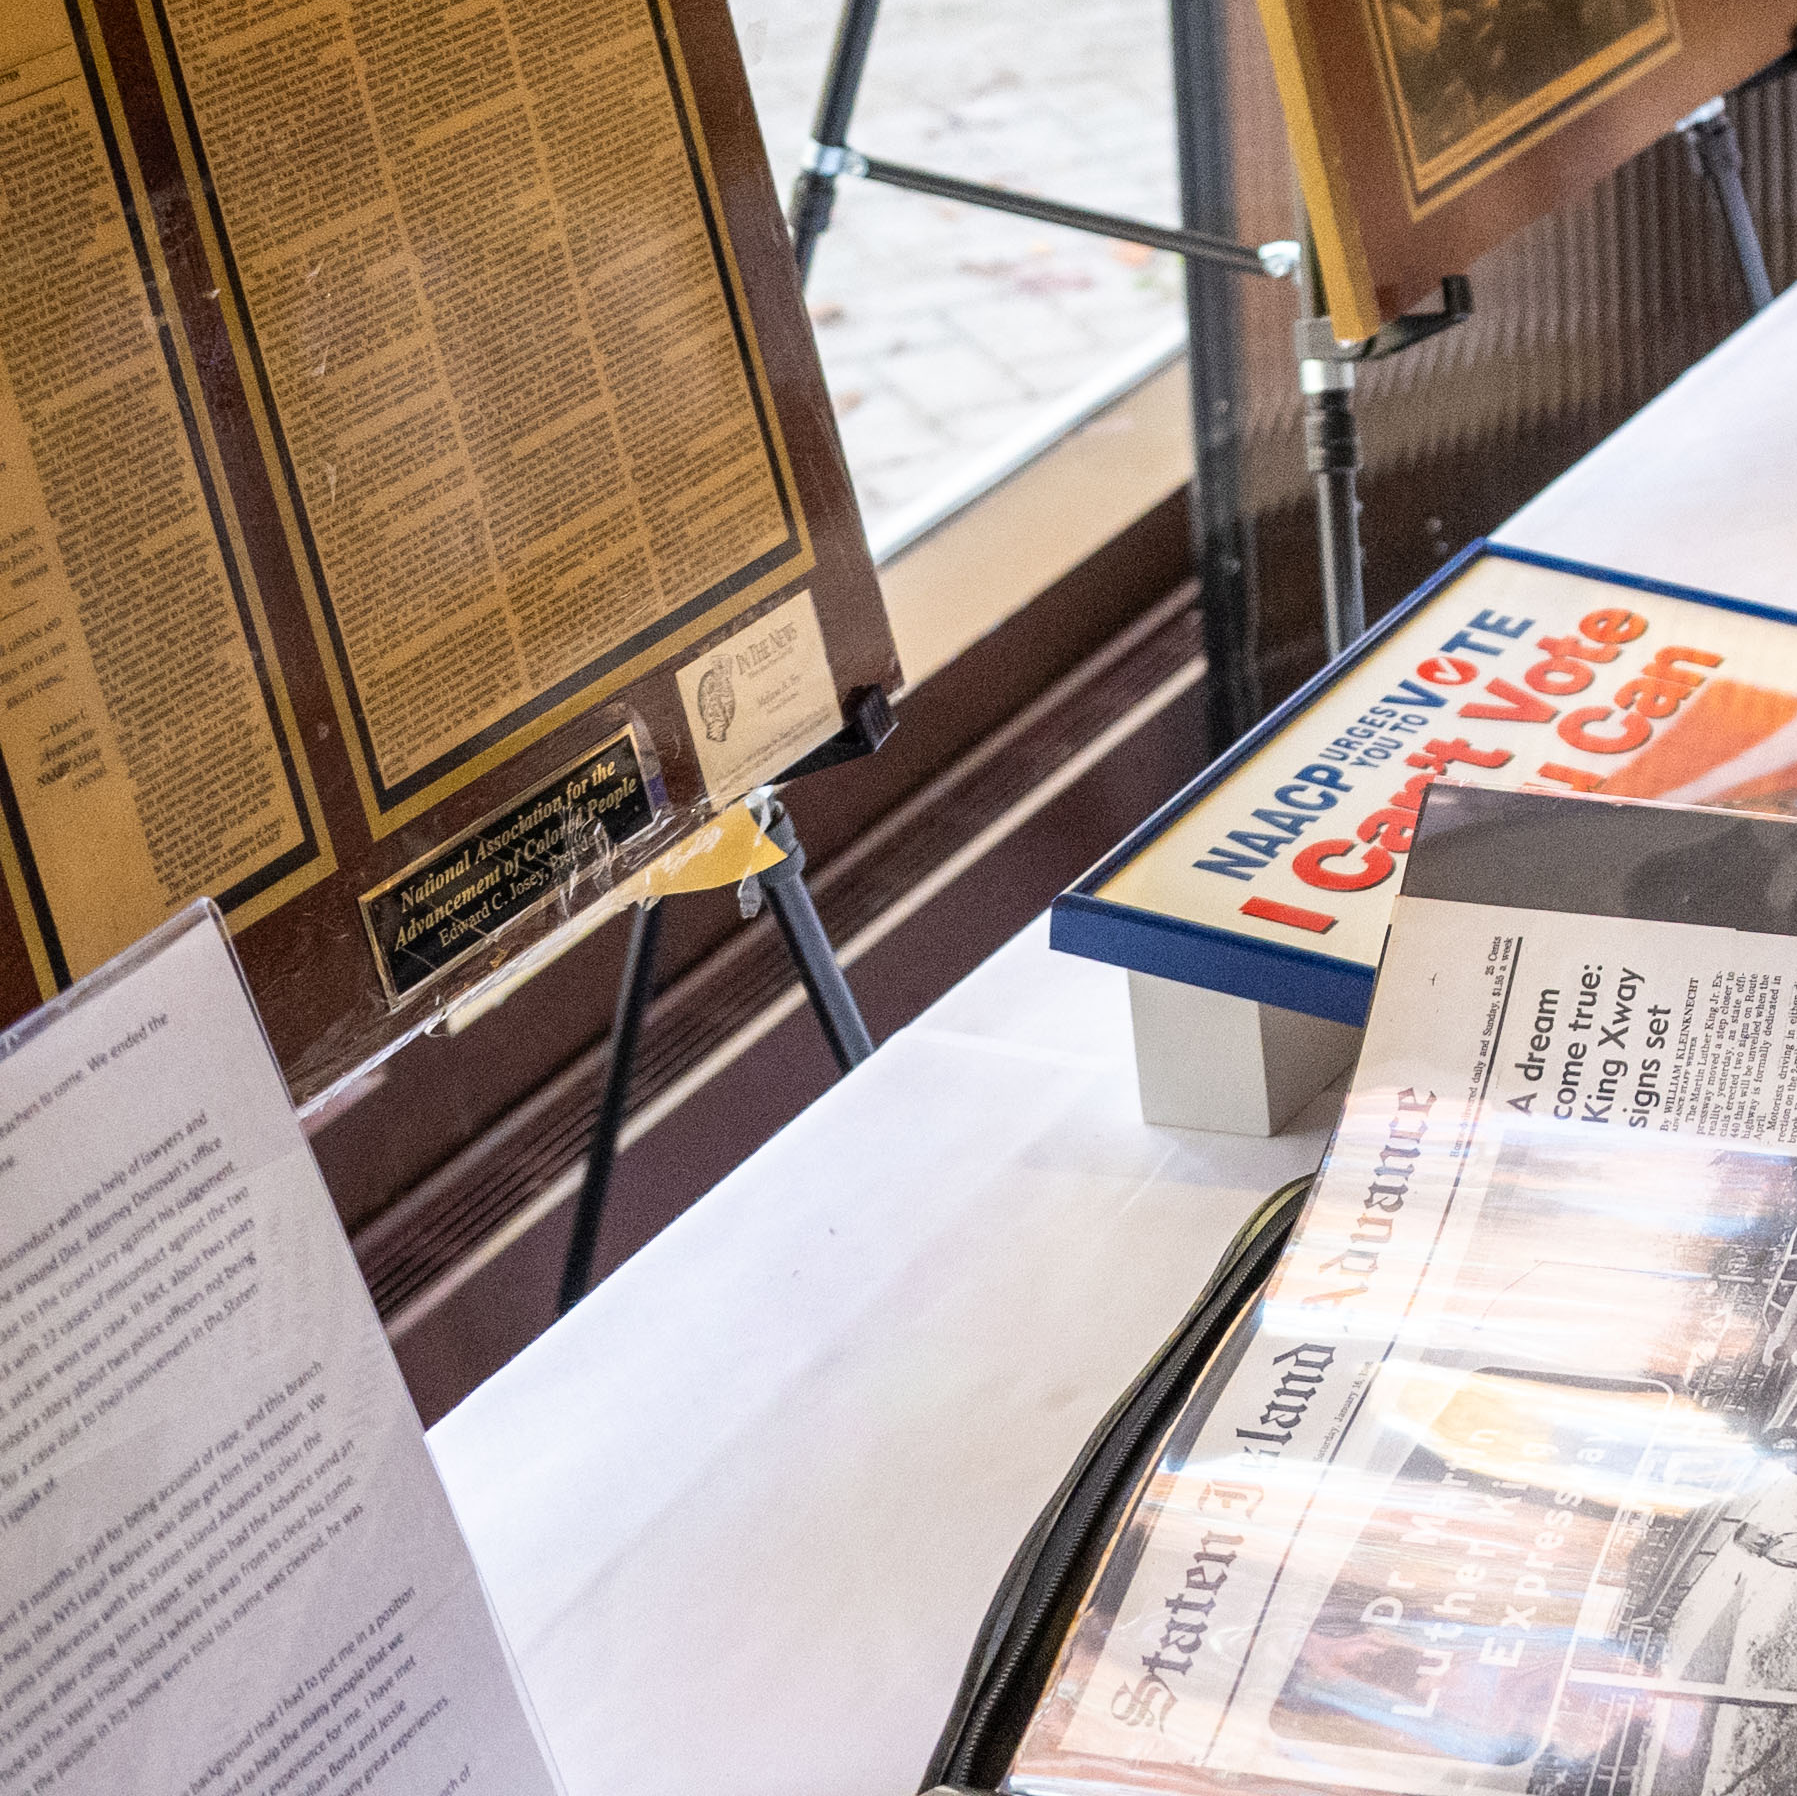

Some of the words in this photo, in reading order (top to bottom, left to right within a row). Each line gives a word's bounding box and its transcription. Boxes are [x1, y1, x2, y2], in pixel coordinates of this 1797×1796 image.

[1382, 611, 1530, 707] VOTE
[1558, 647, 1721, 754] Can
[1320, 707, 1396, 760] URGES
[1350, 736, 1402, 767] YOU
[1389, 714, 1428, 733] TO
[1240, 898, 1336, 933] I
[1460, 609, 1646, 722] Vote
[401, 850, 470, 912] National
[475, 796, 566, 864] Association
[566, 778, 588, 809] for
[591, 760, 615, 785] the
[1195, 764, 1349, 879] NAACP
[395, 865, 499, 950] Advancement
[502, 847, 521, 877] of
[587, 776, 636, 822] People
[439, 901, 490, 947] Edward
[491, 891, 508, 910] C.
[509, 870, 548, 899] Josey,
[1484, 965, 1495, 975] 25
[1487, 936, 1501, 961] Cents
[1501, 937, 1513, 961] week
[1711, 970, 1722, 988] Ex-
[1491, 974, 1504, 996] $1.55
[1568, 964, 1602, 1031] true:
[1597, 967, 1644, 1048] Xway
[1709, 991, 1720, 1004] Jr.
[1479, 1039, 1489, 1056] and
[1482, 1002, 1499, 1036] Sunday,
[1515, 989, 1559, 1080] dream
[1663, 1064, 1682, 1113] WILLIAM
[1675, 977, 1698, 1059] KLEINKNECHT
[1697, 1032, 1711, 1065] Luther
[1704, 1006, 1719, 1030] King
[1471, 1060, 1486, 1083] daily
[1553, 1042, 1586, 1118] come
[1581, 1059, 1627, 1122] King
[1623, 1059, 1660, 1127] signs
[1646, 1004, 1670, 1048] set
[1689, 1068, 1704, 1101] Martin
[1506, 1092, 1537, 1112] A
[1684, 1104, 1697, 1122] The
[2, 1674, 36, 1708] press
[36, 1619, 99, 1677] conference
[100, 1595, 127, 1623] with
[126, 1578, 148, 1600] the
[147, 1548, 183, 1583] Staten
[183, 1516, 218, 1551] Island
[218, 1481, 263, 1524] Advance
[262, 1470, 276, 1486] to
[276, 1447, 302, 1475] clear
[302, 1430, 322, 1451] the
[1109, 1529, 1248, 1734] Staten
[1391, 1541, 1497, 1718] Luther
[190, 1730, 253, 1794] background
[254, 1710, 278, 1737] that
[276, 1703, 284, 1716] I
[282, 1683, 305, 1710] had
[303, 1675, 318, 1691] to
[318, 1656, 338, 1682] put
[337, 1641, 356, 1661] me
[355, 1630, 367, 1645] in
[368, 1623, 376, 1635] a
[375, 1586, 415, 1631] position
